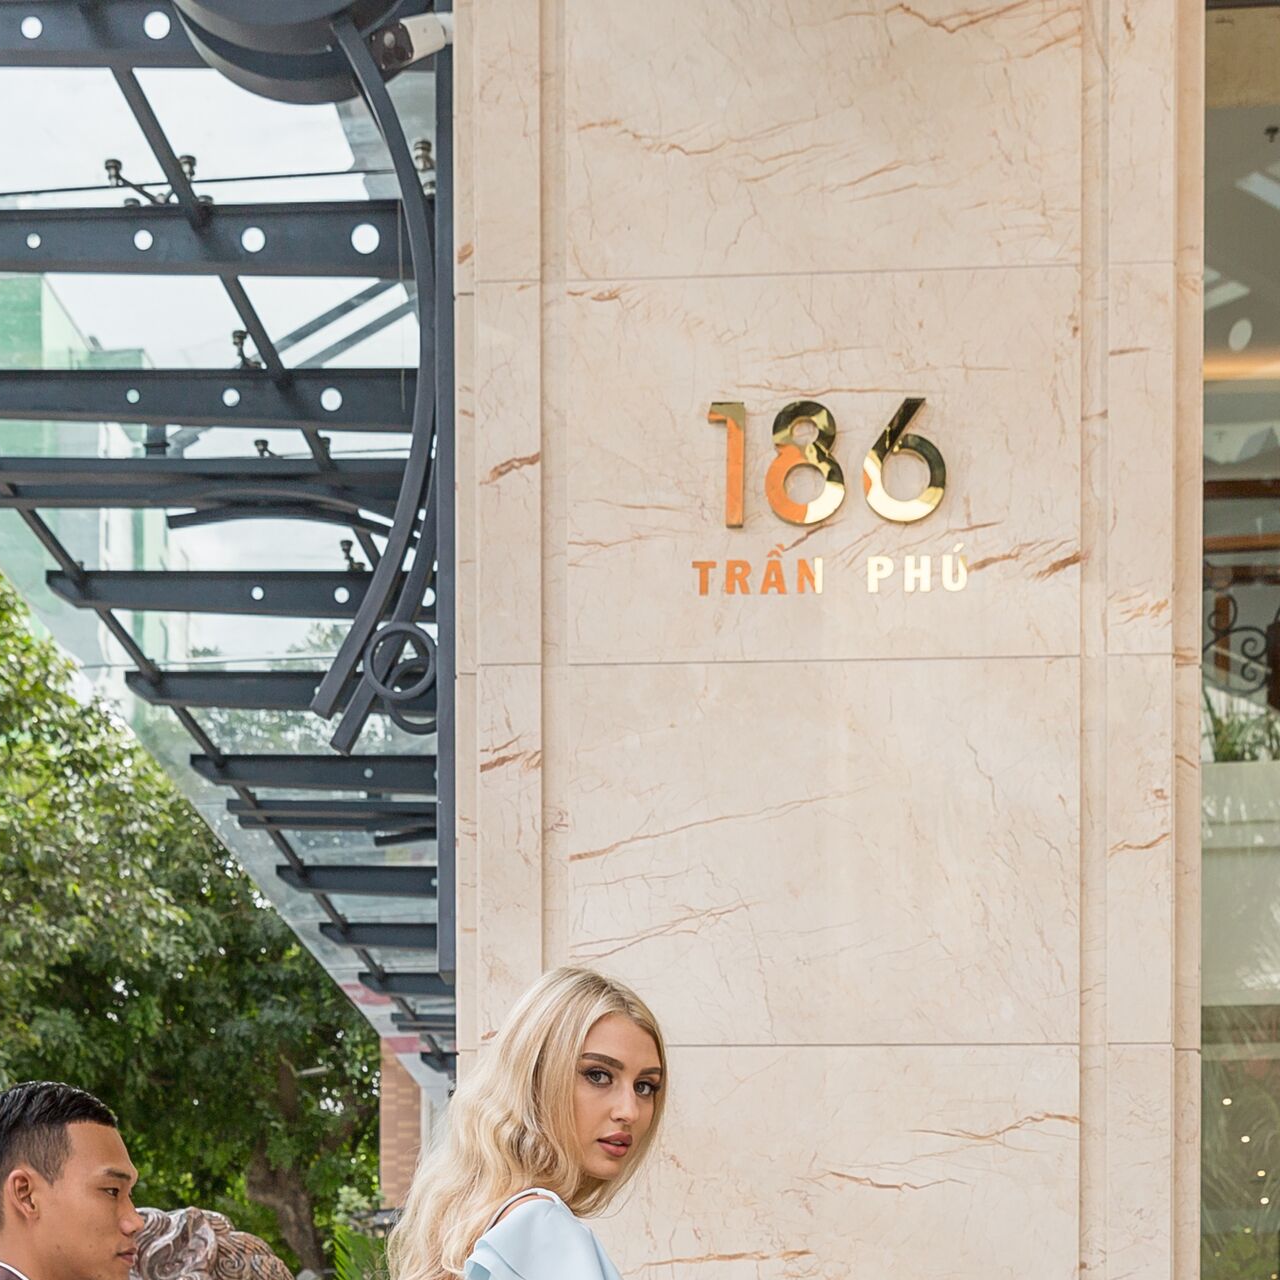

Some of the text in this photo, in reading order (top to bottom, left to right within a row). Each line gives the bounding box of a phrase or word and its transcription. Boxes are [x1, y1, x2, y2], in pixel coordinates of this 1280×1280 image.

[707, 397, 948, 528] 186
[692, 542, 969, 596] TRẦN PHÚ
